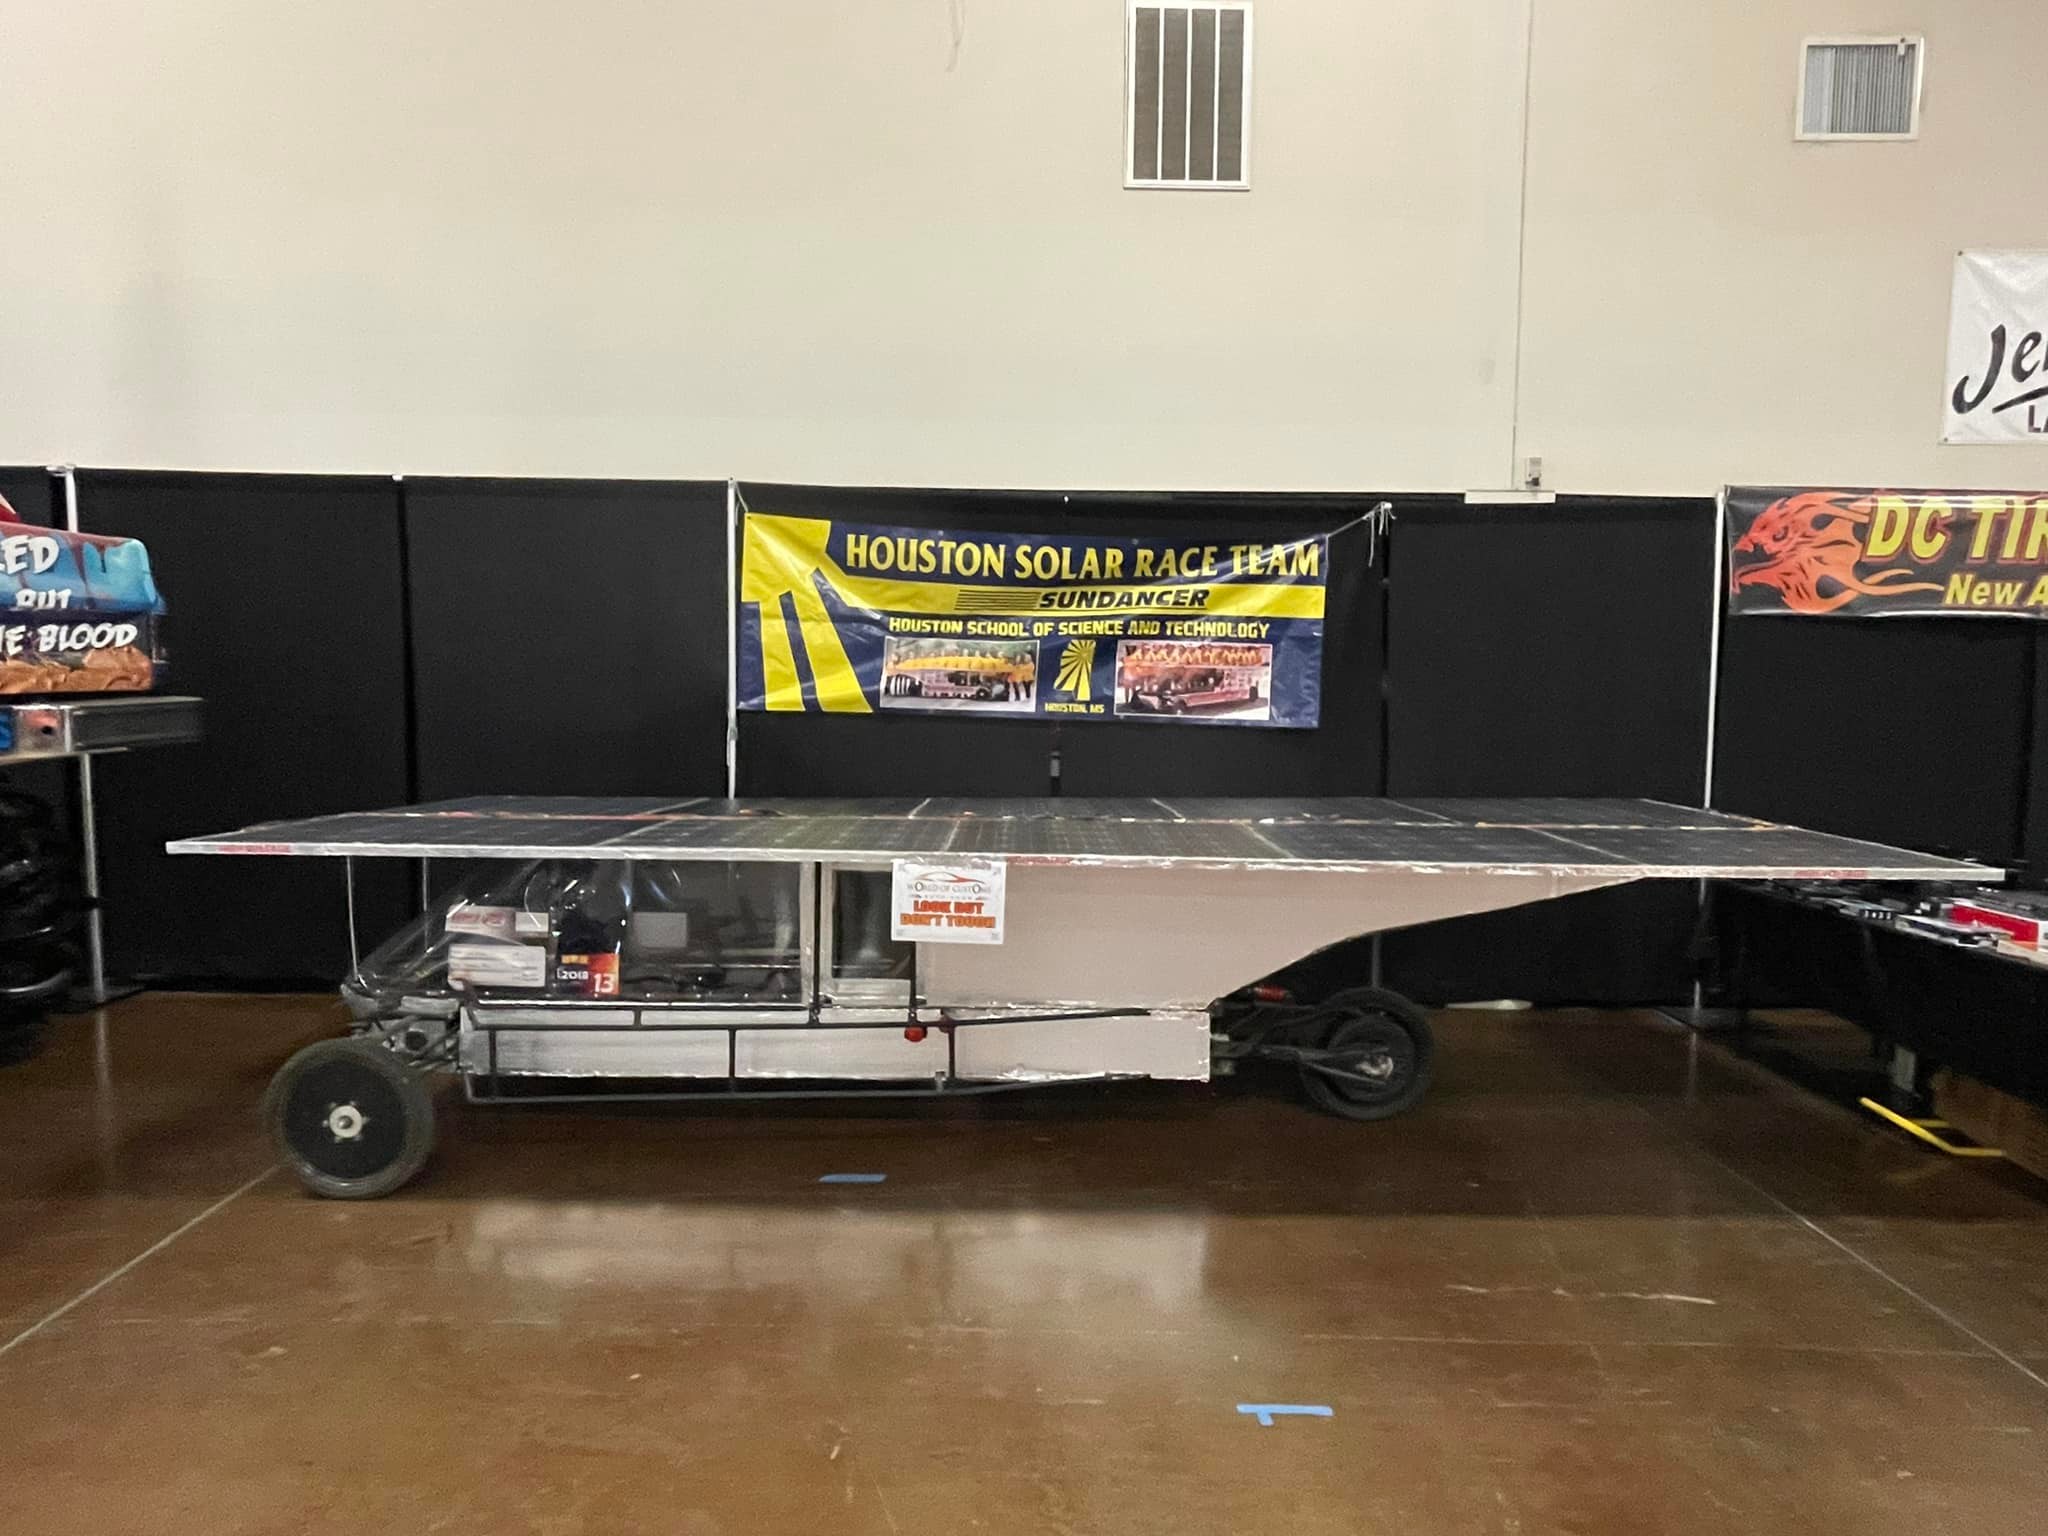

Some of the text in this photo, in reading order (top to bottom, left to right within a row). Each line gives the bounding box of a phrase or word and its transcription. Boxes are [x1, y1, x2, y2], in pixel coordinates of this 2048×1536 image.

[1952, 324, 2048, 414] Je
[1864, 495, 1953, 560] DC
[0, 535, 60, 575] ED
[846, 533, 1320, 580] HOUSTON SOLAR RACE TEAM
[1039, 588, 1210, 609] SUNDANCER
[1944, 573, 2023, 606] New
[37, 622, 138, 653] BLOOD
[888, 617, 1270, 639] HOUSTON SCHOOL OF SCIENCE AND TECHNOLOGY
[594, 973, 616, 993] 13
